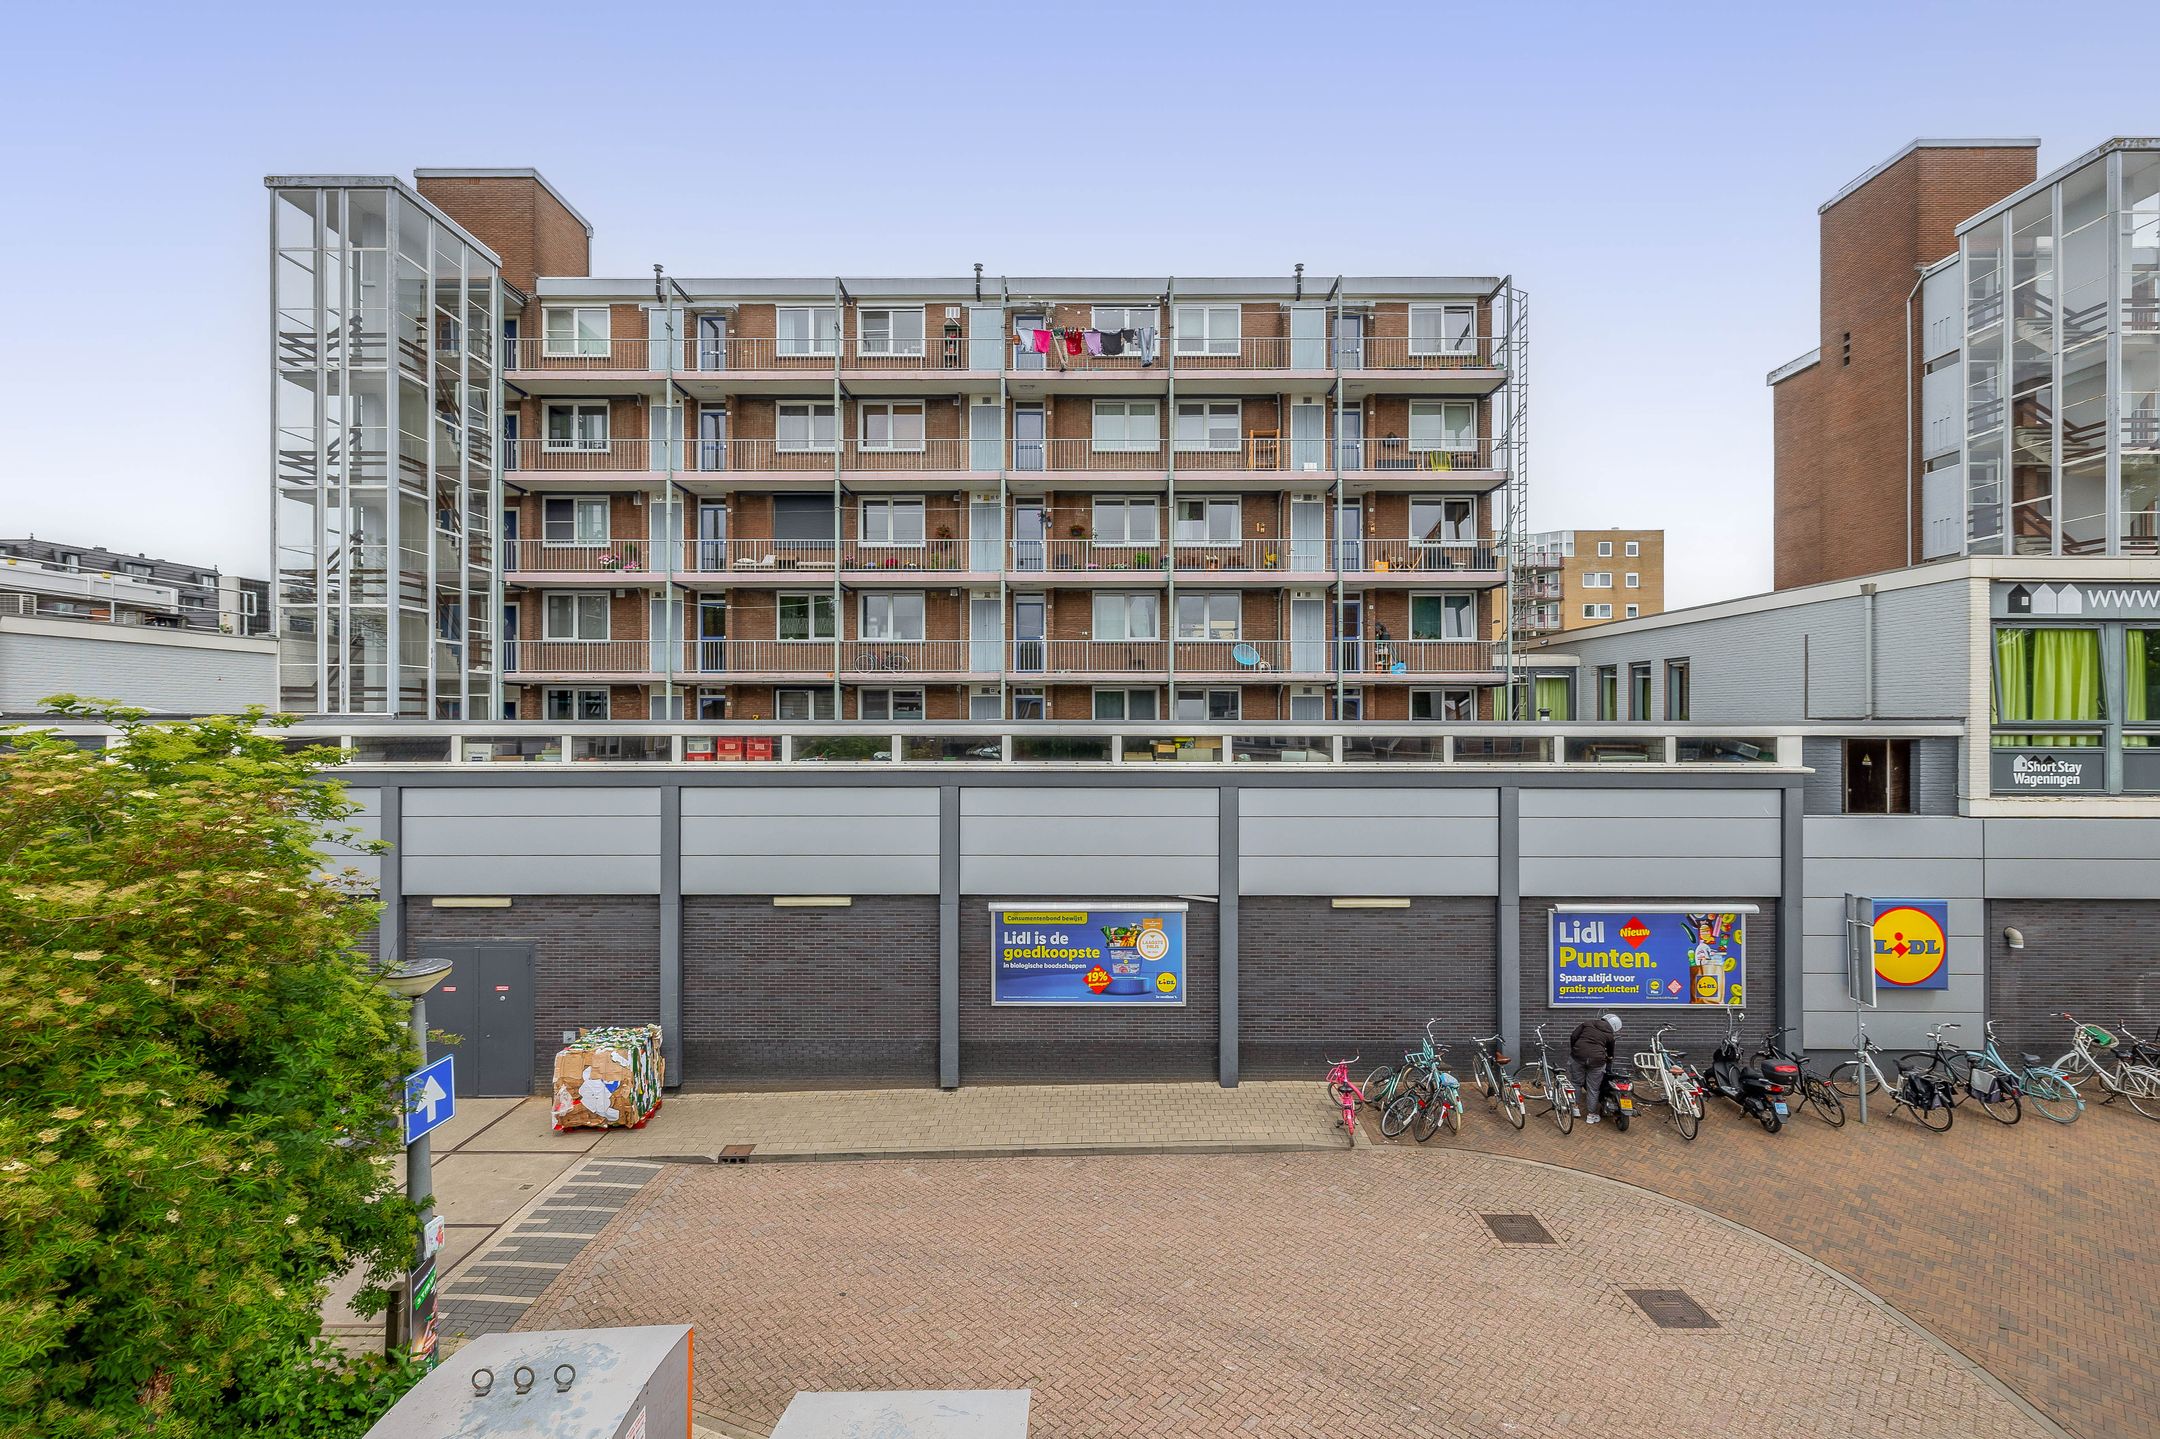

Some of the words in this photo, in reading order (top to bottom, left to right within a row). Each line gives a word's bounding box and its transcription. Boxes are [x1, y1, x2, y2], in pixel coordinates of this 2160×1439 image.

[2027, 760, 2057, 773] Short
[2057, 760, 2082, 775] Stay
[2013, 772, 2081, 787] Wageningen
[1004, 930, 1031, 945] Lidl
[1034, 930, 1047, 945] is
[1050, 931, 1069, 945] de
[1559, 920, 1605, 943] Lidl
[1620, 927, 1651, 937] Nieuw
[1874, 932, 1940, 958] LIDL
[1003, 945, 1101, 961] goedkoopste
[1559, 946, 1658, 968] Punten.
[1087, 971, 1108, 982] 19%
[1559, 973, 1587, 984] Spaar
[1587, 973, 1612, 984] altijd
[1613, 974, 1636, 983] voor
[1559, 984, 1586, 995] gratis
[1587, 984, 1640, 995] producten!
